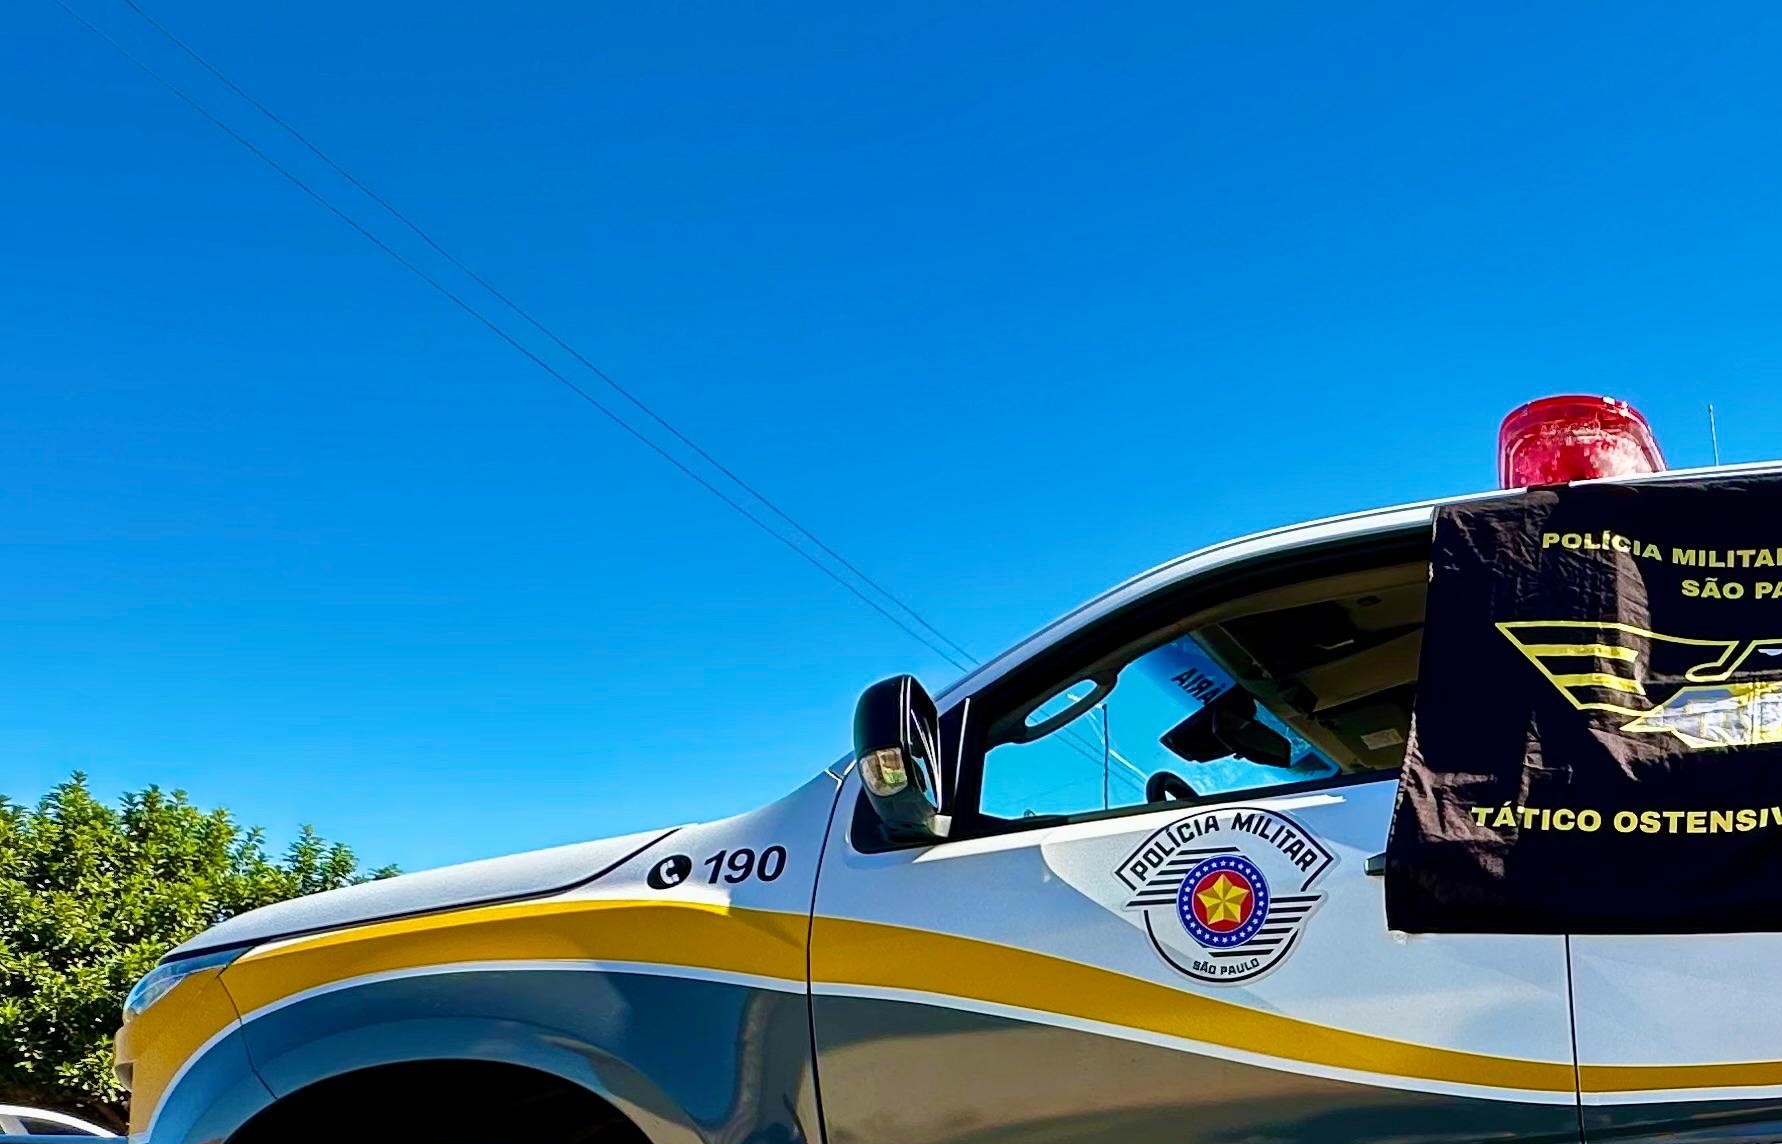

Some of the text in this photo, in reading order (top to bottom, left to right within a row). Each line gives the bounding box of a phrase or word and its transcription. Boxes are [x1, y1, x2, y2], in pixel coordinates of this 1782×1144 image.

[1541, 529, 1663, 562] POLÍCIA
[1681, 576, 1745, 600] SÃO
[1471, 799, 1602, 833] TÁTICO
[1129, 812, 1318, 882] POLÍCIA MILITAR
[704, 845, 787, 884] 190
[1192, 957, 1260, 975] SÃO PAULO
